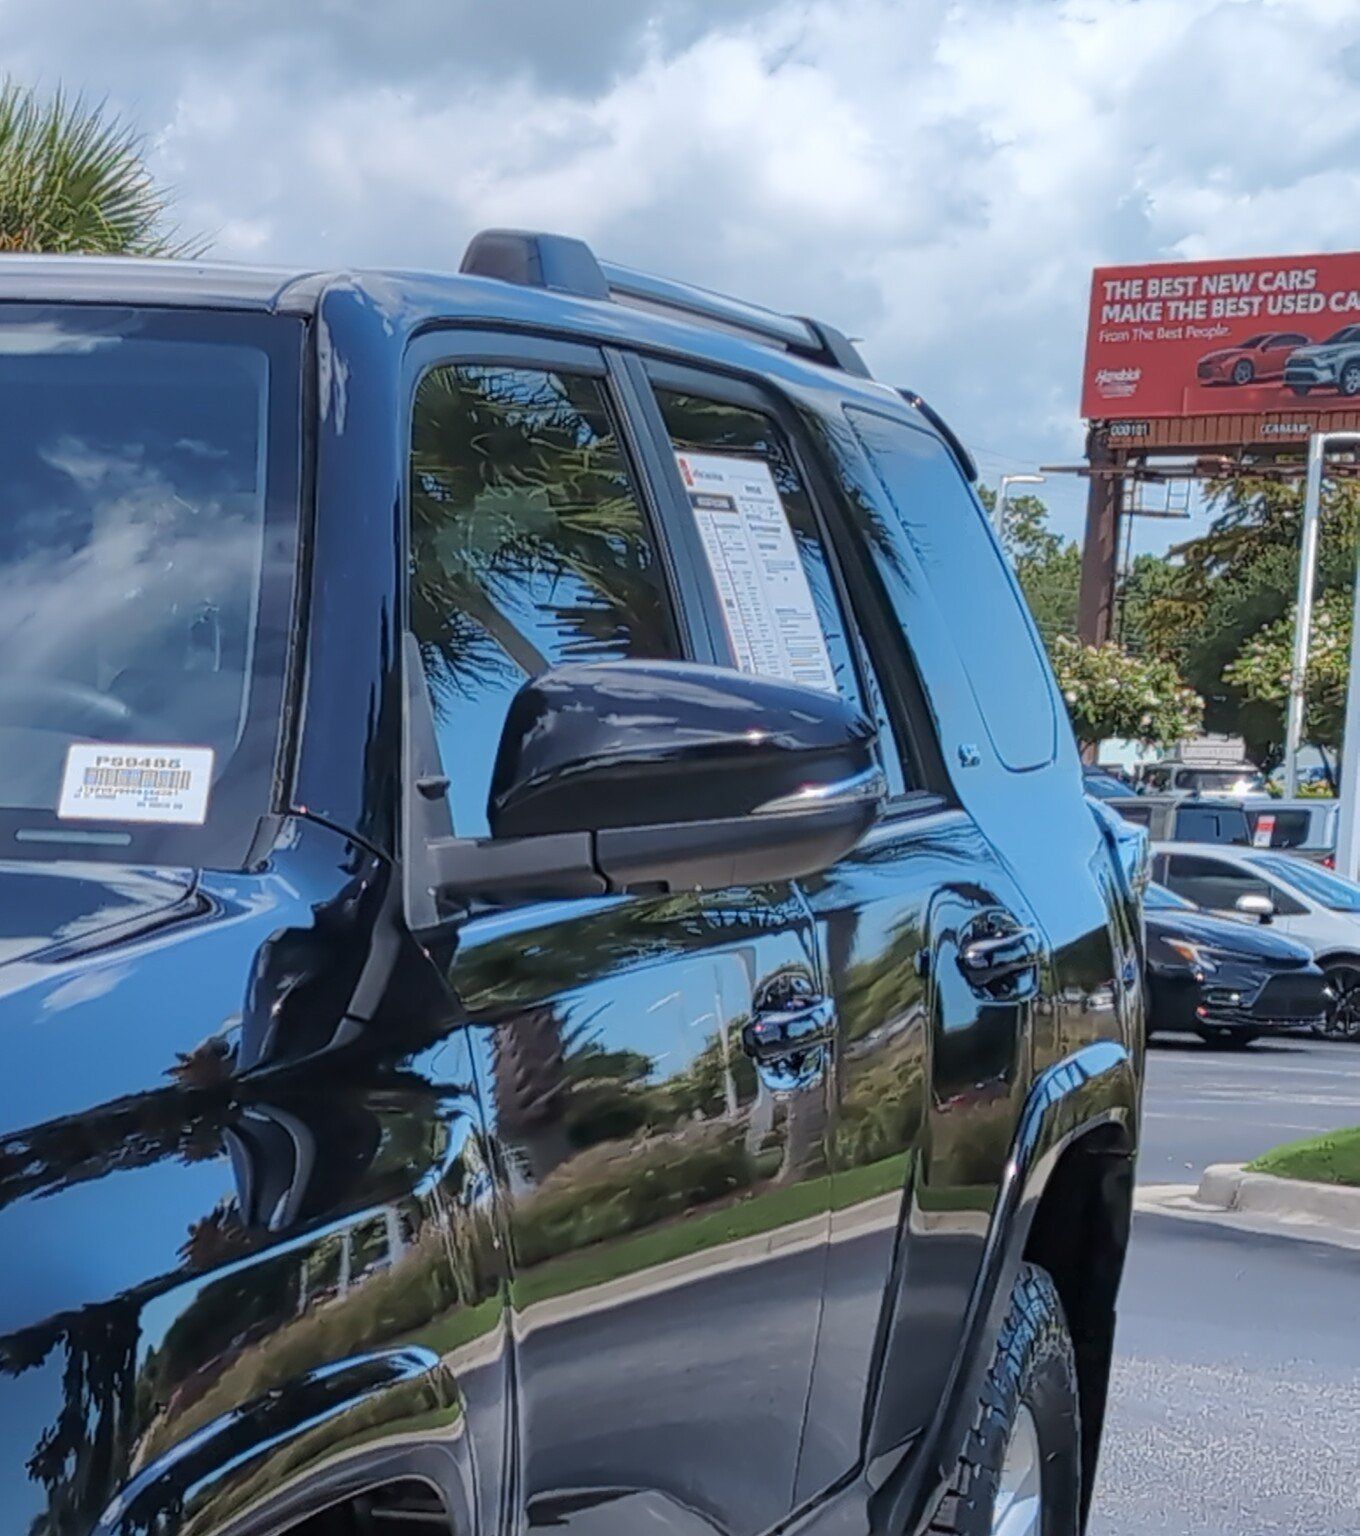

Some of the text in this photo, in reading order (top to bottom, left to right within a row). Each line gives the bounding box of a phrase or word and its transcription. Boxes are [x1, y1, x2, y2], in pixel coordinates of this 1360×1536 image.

[1103, 268, 1317, 300] THE BEST NEW CARS
[1101, 302, 1162, 324] MAKE
[1166, 299, 1207, 320] THE
[1211, 296, 1263, 318] BEST
[1266, 293, 1326, 316] USED
[1132, 327, 1154, 340] The
[1157, 326, 1182, 339] Best
